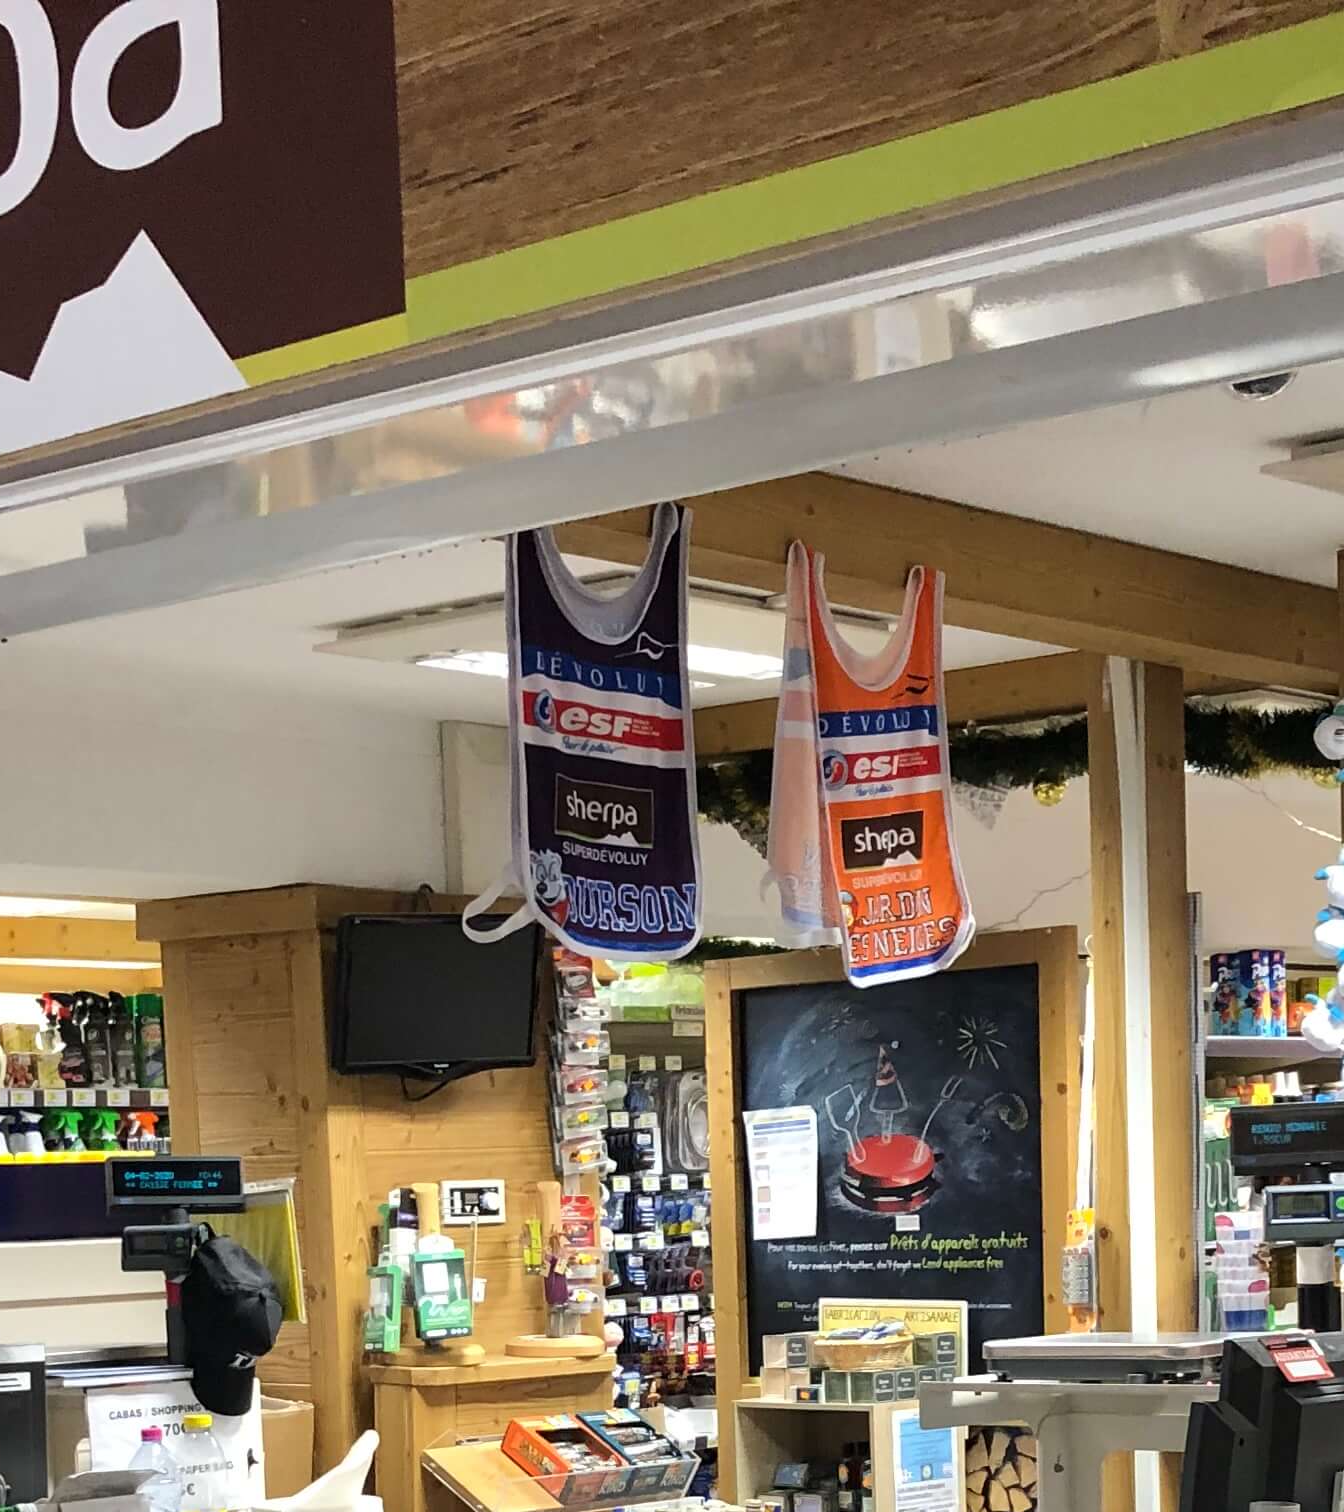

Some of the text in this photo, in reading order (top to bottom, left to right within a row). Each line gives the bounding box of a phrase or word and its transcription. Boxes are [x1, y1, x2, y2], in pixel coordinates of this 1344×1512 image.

[566, 790, 639, 830] sherpa
[890, 1233, 919, 1250] Prêts
[981, 1230, 1028, 1254] gratuits
[904, 1311, 960, 1323] ARTISANALE
[108, 1409, 142, 1420] CABAS
[151, 1403, 202, 1416] SHOPPING
